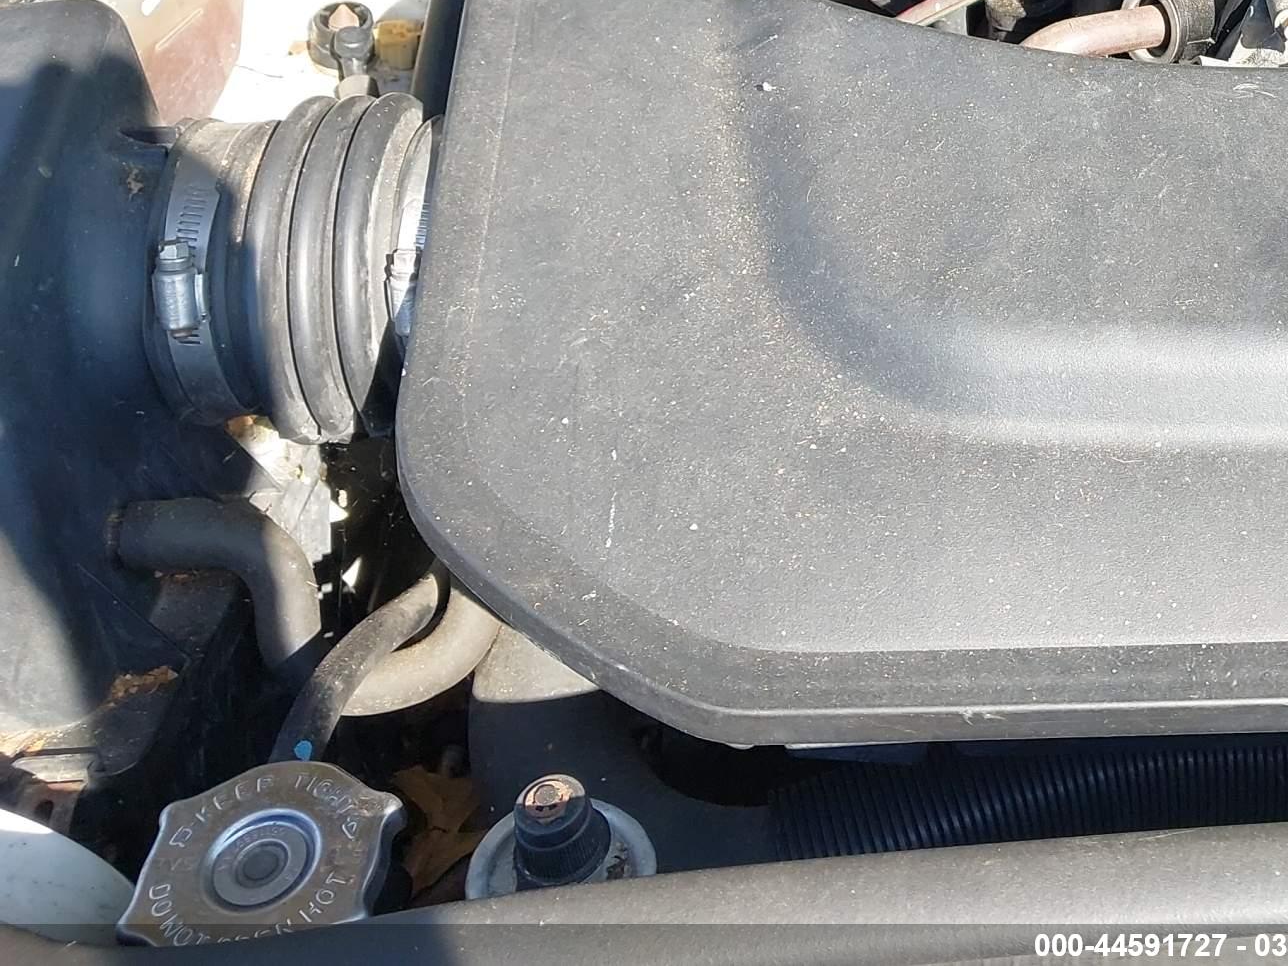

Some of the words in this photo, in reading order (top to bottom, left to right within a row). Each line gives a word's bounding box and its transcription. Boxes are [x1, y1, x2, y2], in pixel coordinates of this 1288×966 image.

[194, 776, 275, 823] KEEP
[149, 883, 173, 917] DO
[299, 872, 346, 923] HOT
